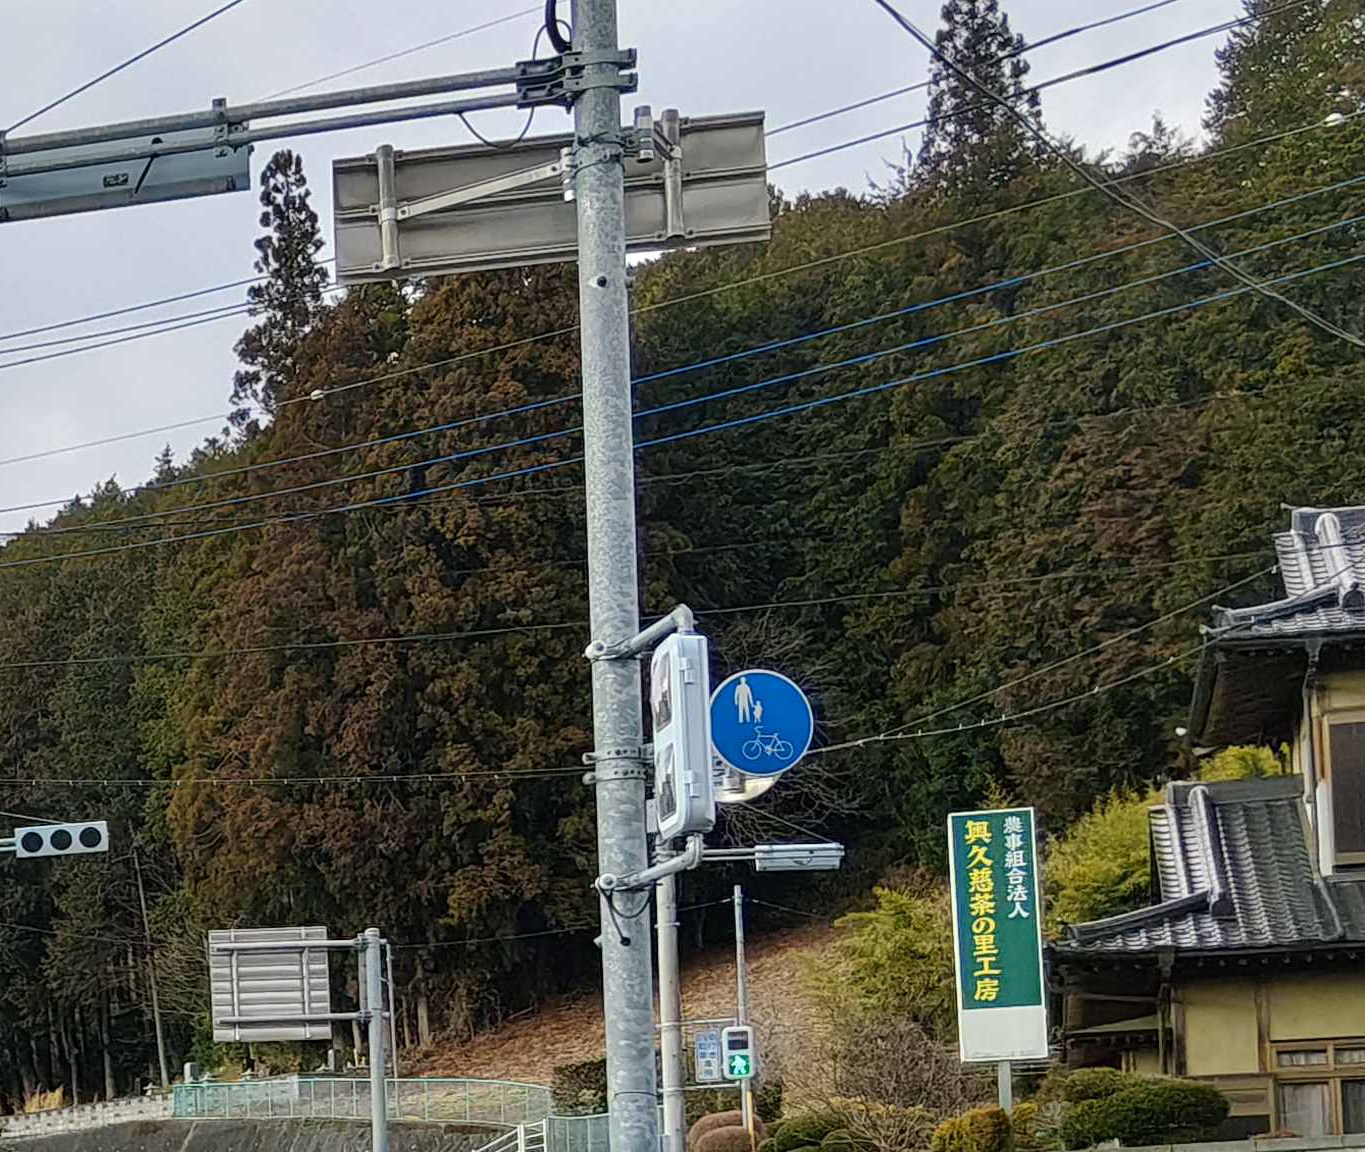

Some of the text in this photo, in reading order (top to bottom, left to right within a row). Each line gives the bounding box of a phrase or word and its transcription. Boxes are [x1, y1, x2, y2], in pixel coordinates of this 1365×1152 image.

[1002, 816, 1030, 919] 農事組合法人
